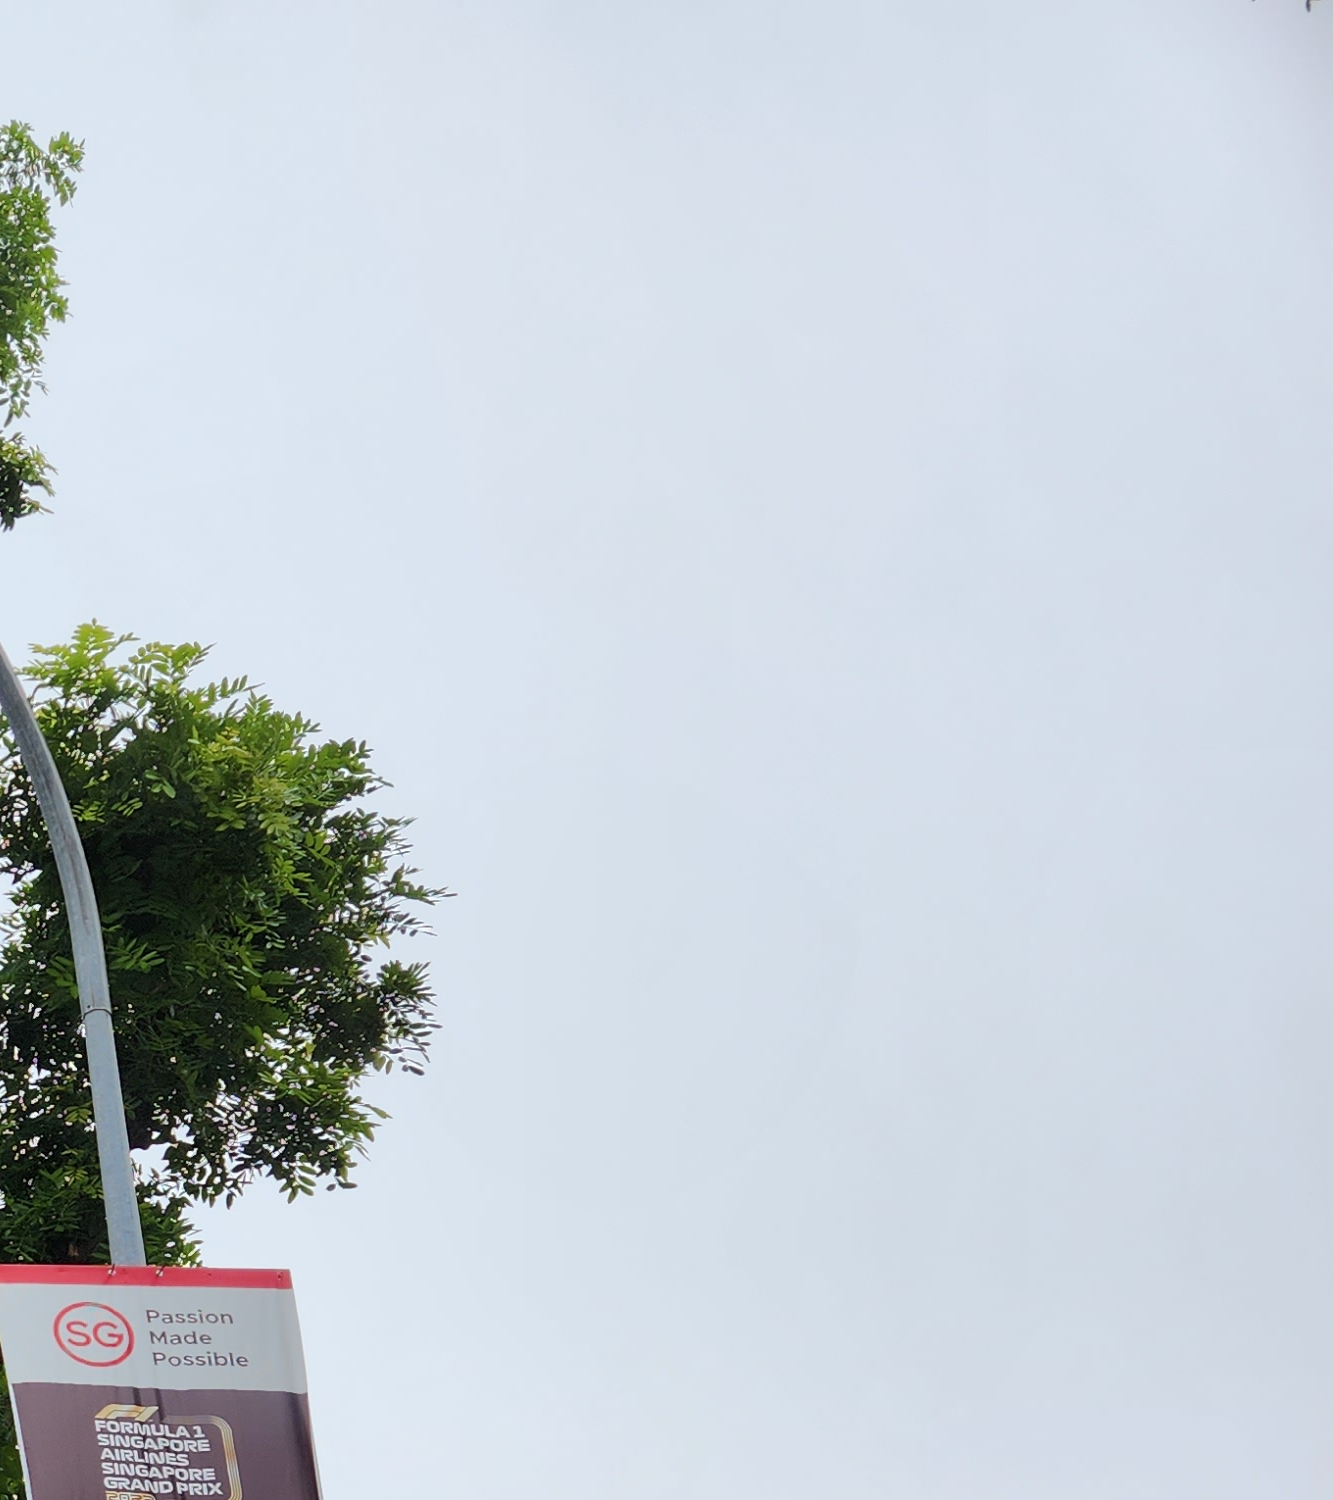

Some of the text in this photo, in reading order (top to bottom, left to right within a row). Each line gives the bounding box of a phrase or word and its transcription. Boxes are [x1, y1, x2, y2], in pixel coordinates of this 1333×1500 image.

[145, 1309, 234, 1325] Passion
[65, 1320, 124, 1348] SG
[149, 1330, 213, 1345] Made
[152, 1351, 249, 1367] Possible
[94, 1420, 205, 1438] FORMULA 1
[97, 1433, 211, 1452] SINGAPORE
[100, 1447, 190, 1466] AIRLINES
[101, 1462, 216, 1482] SINGAPORE
[103, 1476, 224, 1496] GRAND PRIX
